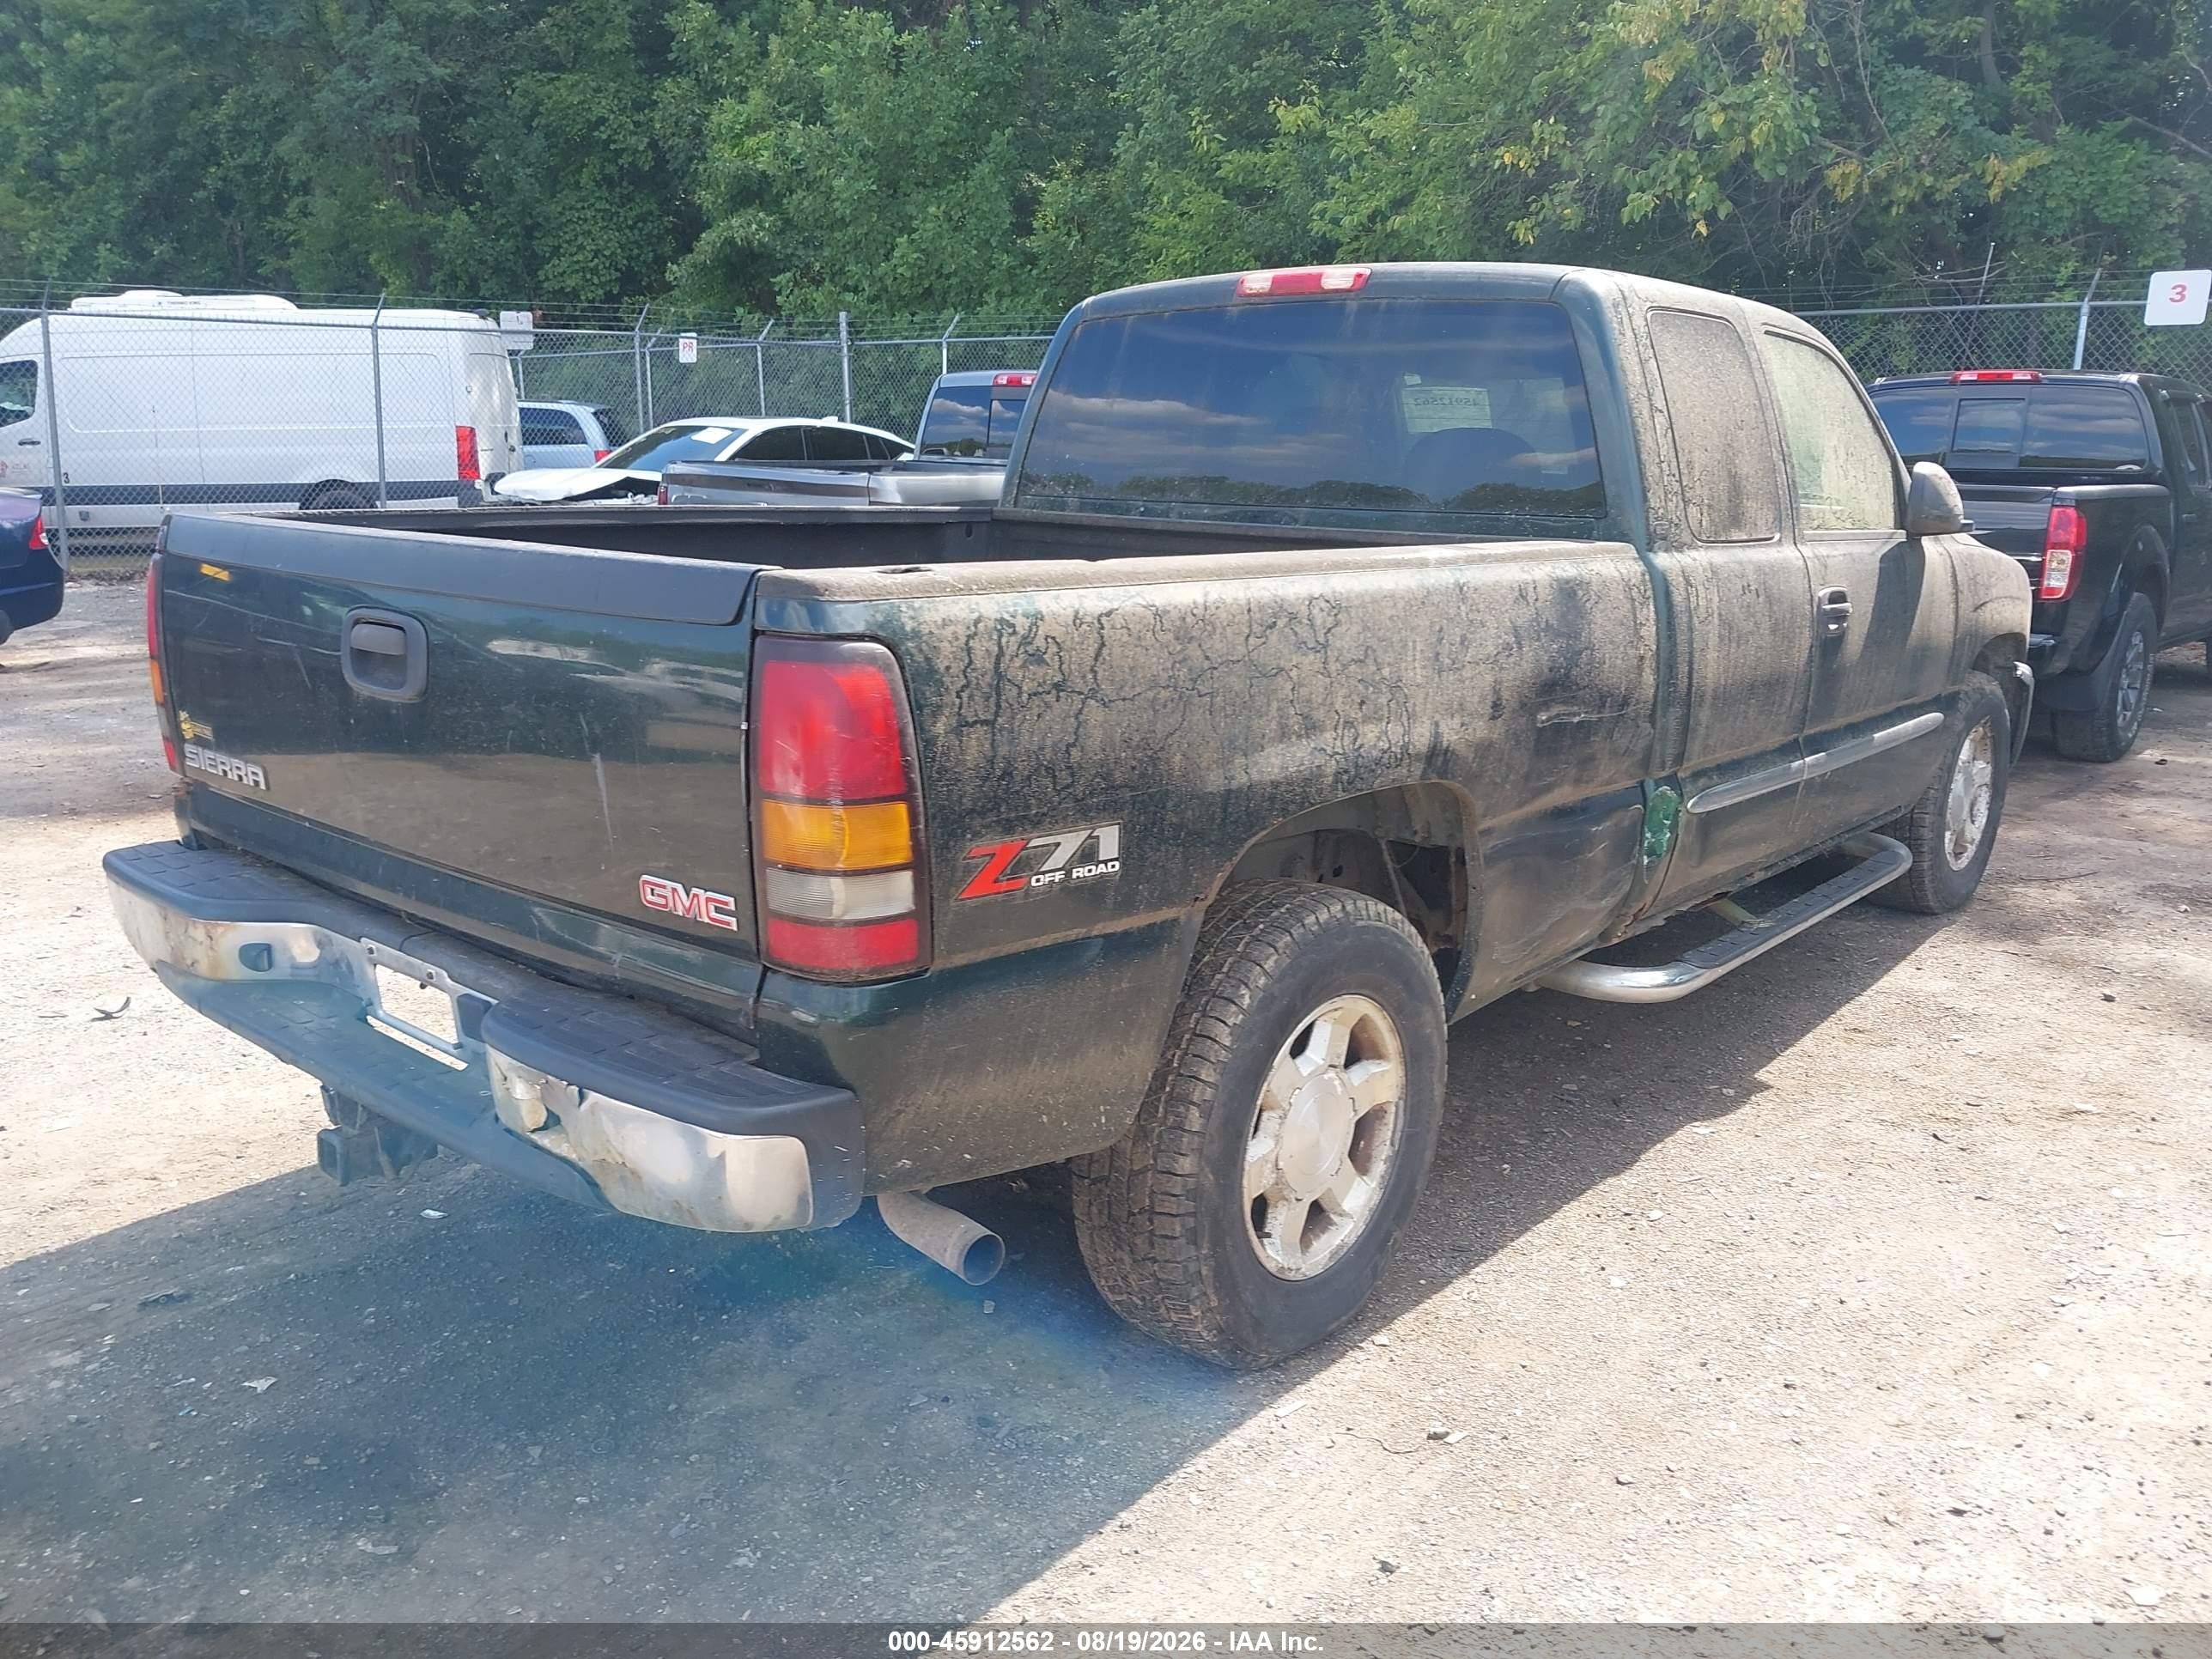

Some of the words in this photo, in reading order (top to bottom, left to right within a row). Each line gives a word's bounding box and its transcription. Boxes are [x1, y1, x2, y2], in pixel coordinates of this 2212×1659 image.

[2169, 283, 2187, 302] 3
[683, 342, 694, 353] PR
[184, 743, 266, 790] SIERRA
[957, 823, 1121, 901] Z71
[1030, 871, 1066, 887] OFF
[1072, 860, 1121, 878] ROAD
[638, 874, 738, 932] GMC
